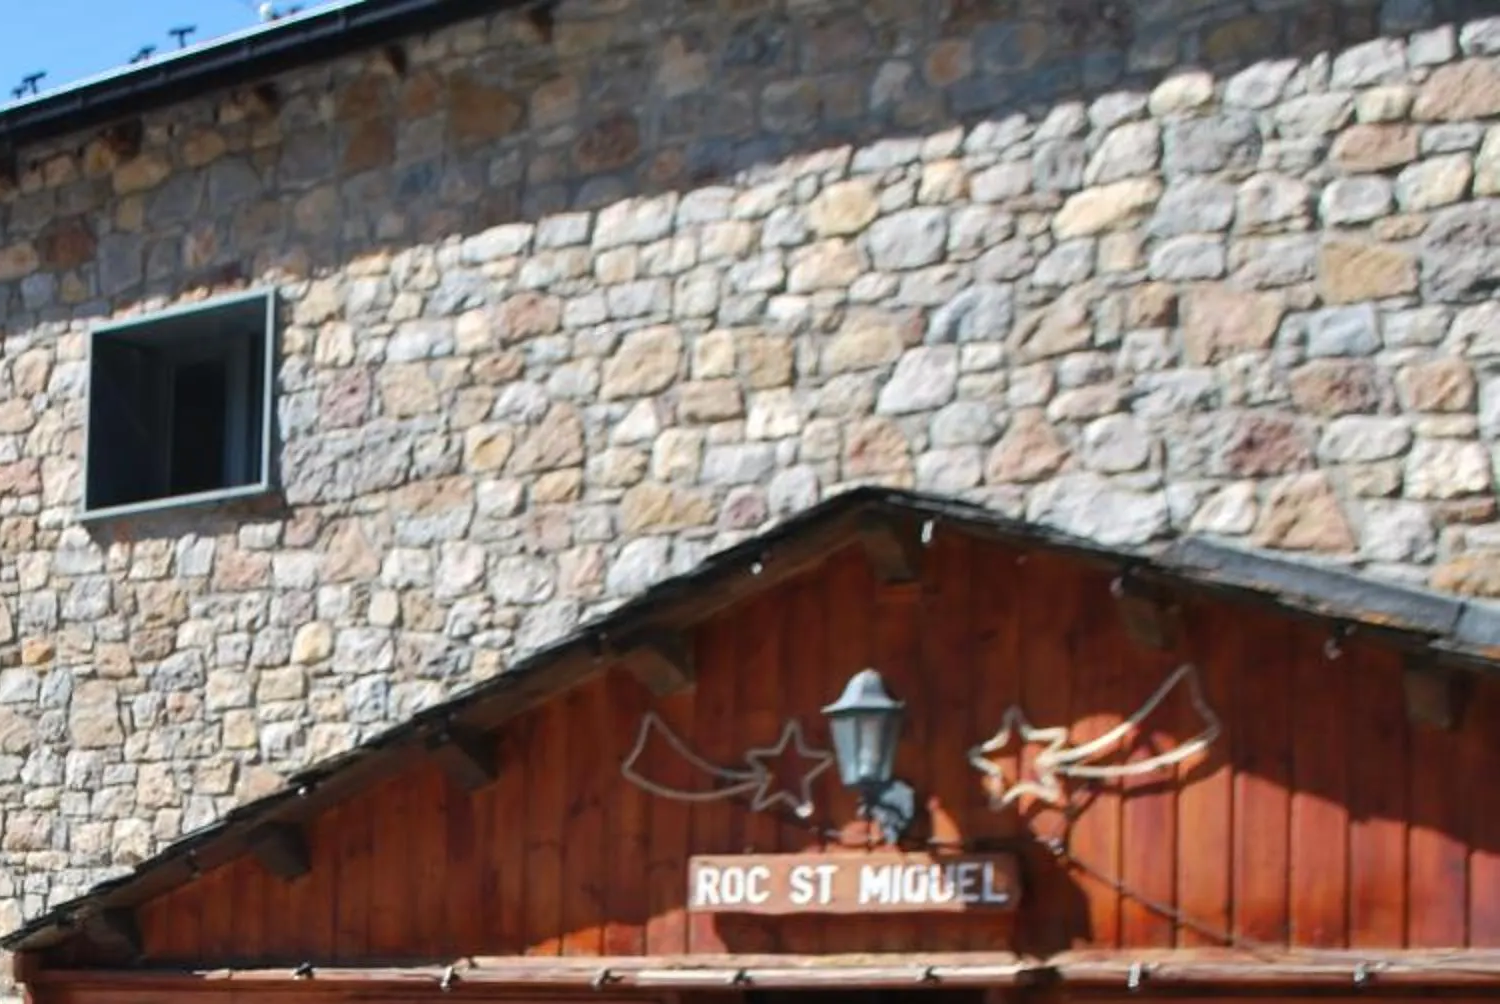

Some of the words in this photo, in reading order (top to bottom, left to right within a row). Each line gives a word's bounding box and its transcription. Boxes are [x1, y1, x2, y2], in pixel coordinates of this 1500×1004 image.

[696, 864, 770, 905] ROC
[789, 864, 839, 904] ST
[858, 861, 1009, 905] MIGUEL
